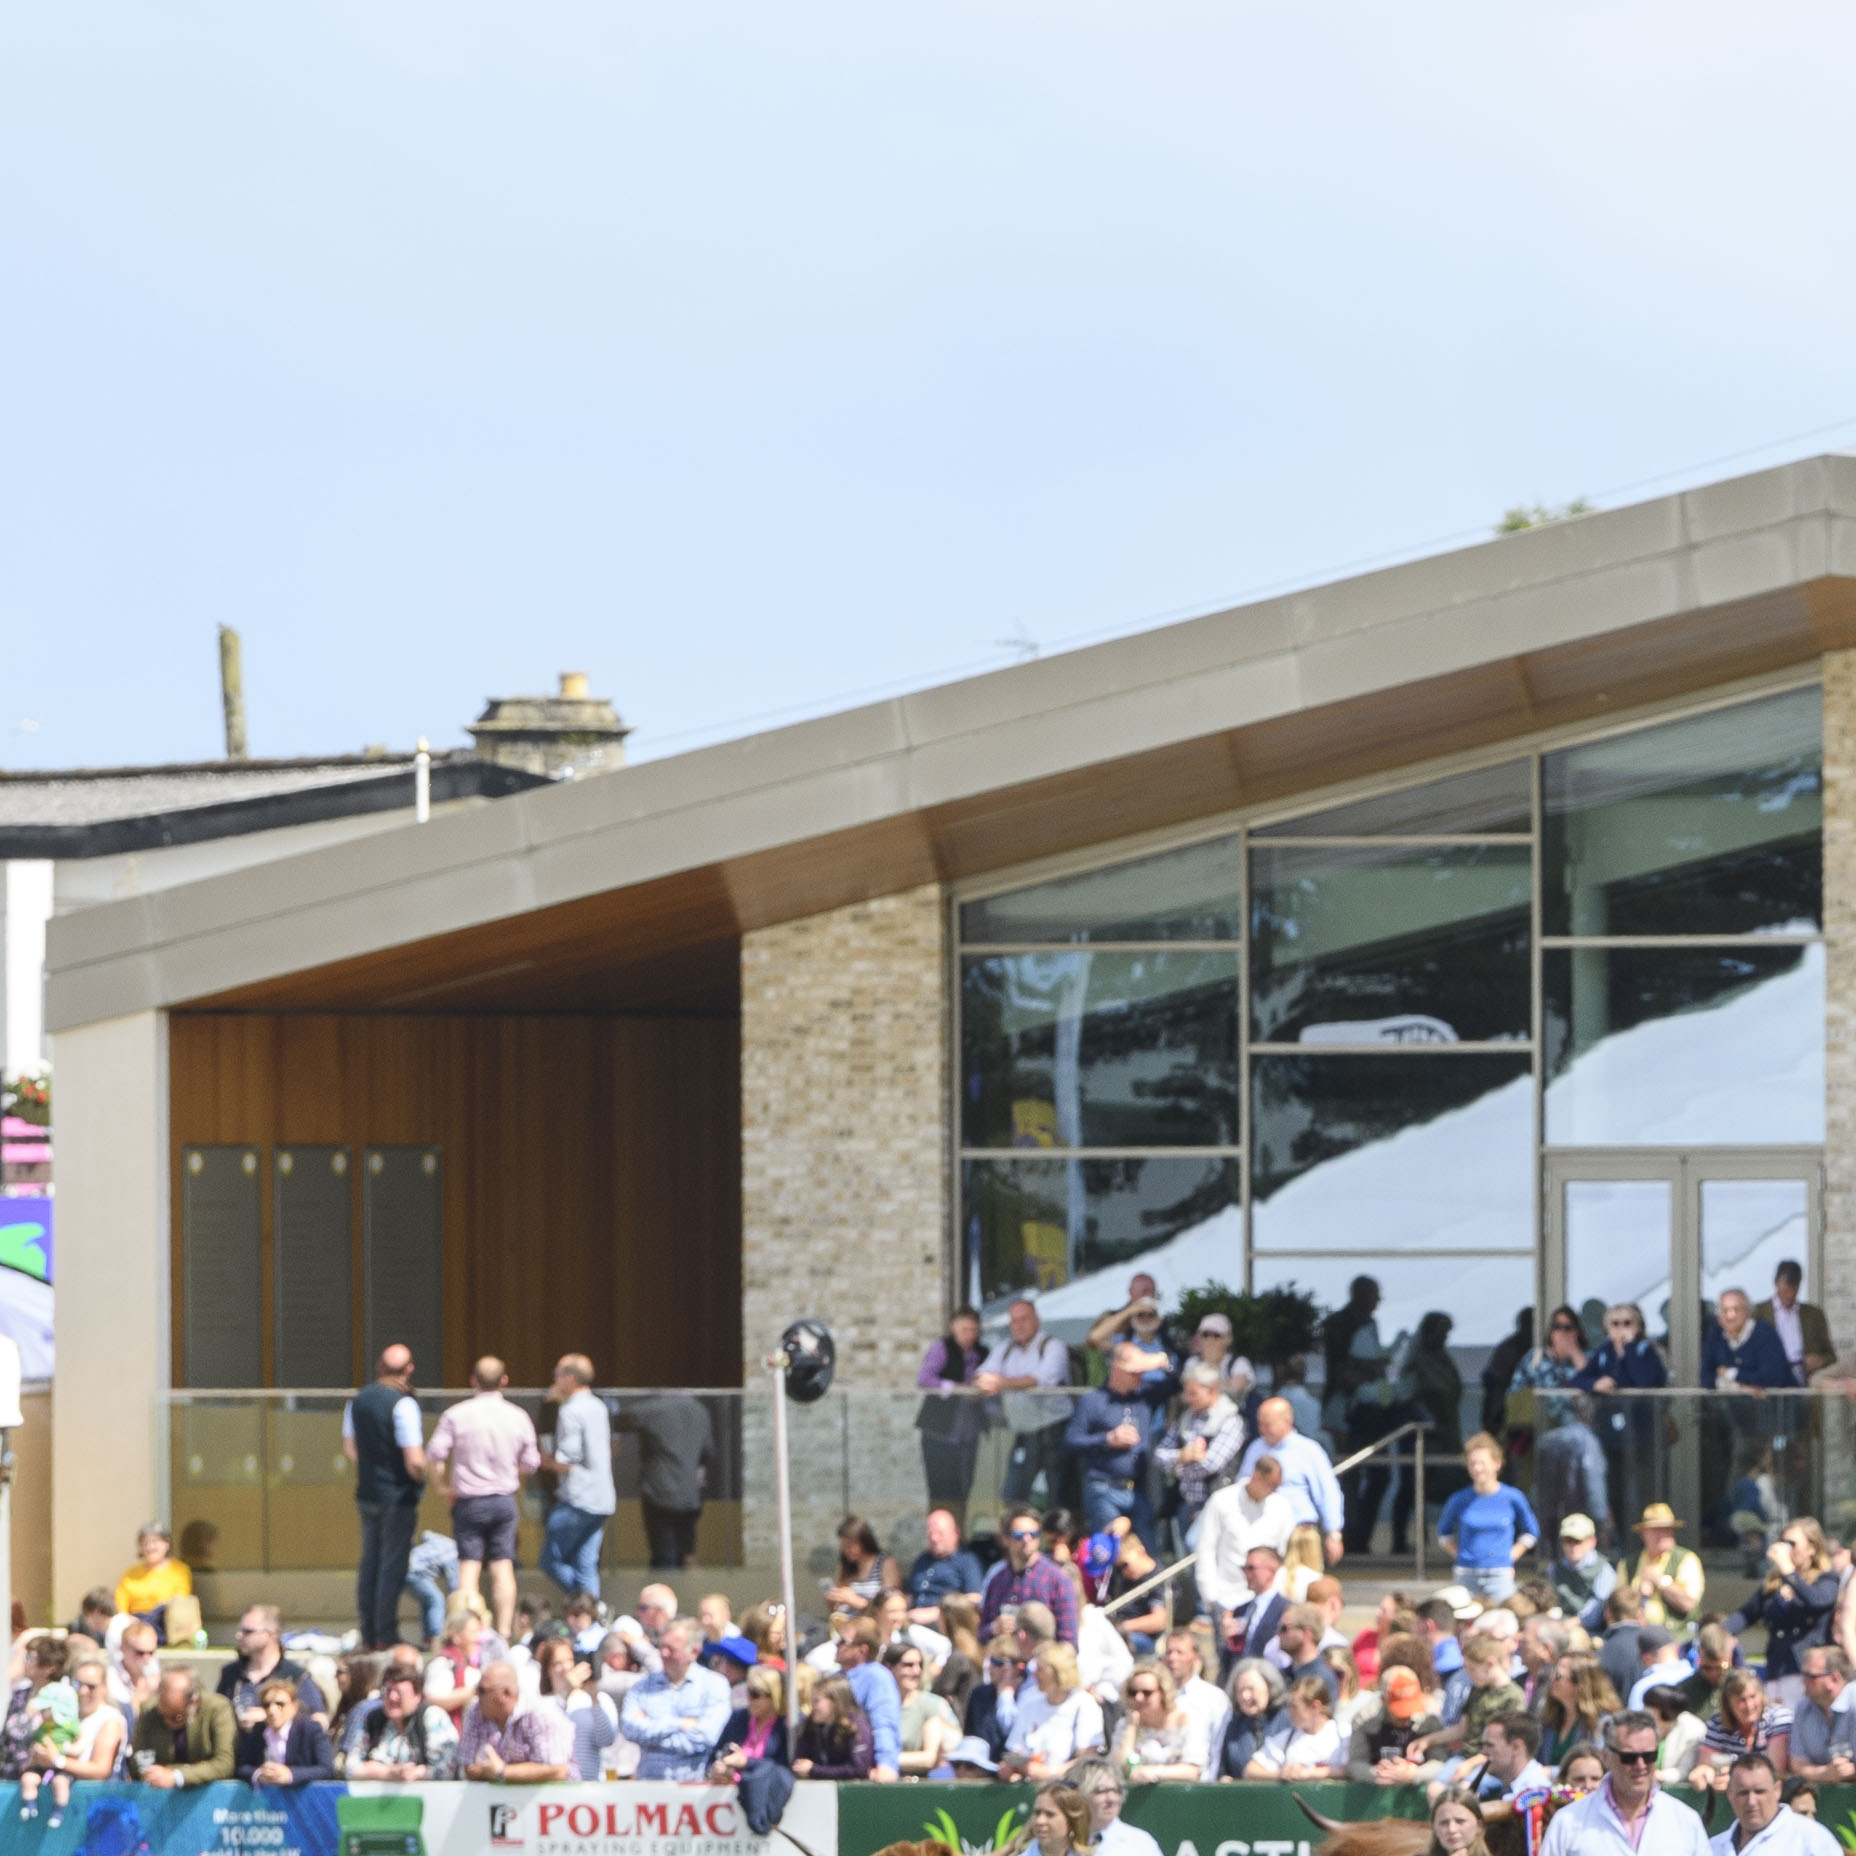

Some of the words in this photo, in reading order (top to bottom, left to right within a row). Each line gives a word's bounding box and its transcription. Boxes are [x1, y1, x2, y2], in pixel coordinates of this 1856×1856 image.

[212, 1808, 253, 1824] More
[537, 1802, 737, 1838] POLMAC
[536, 1840, 642, 1856] SPRAYING
